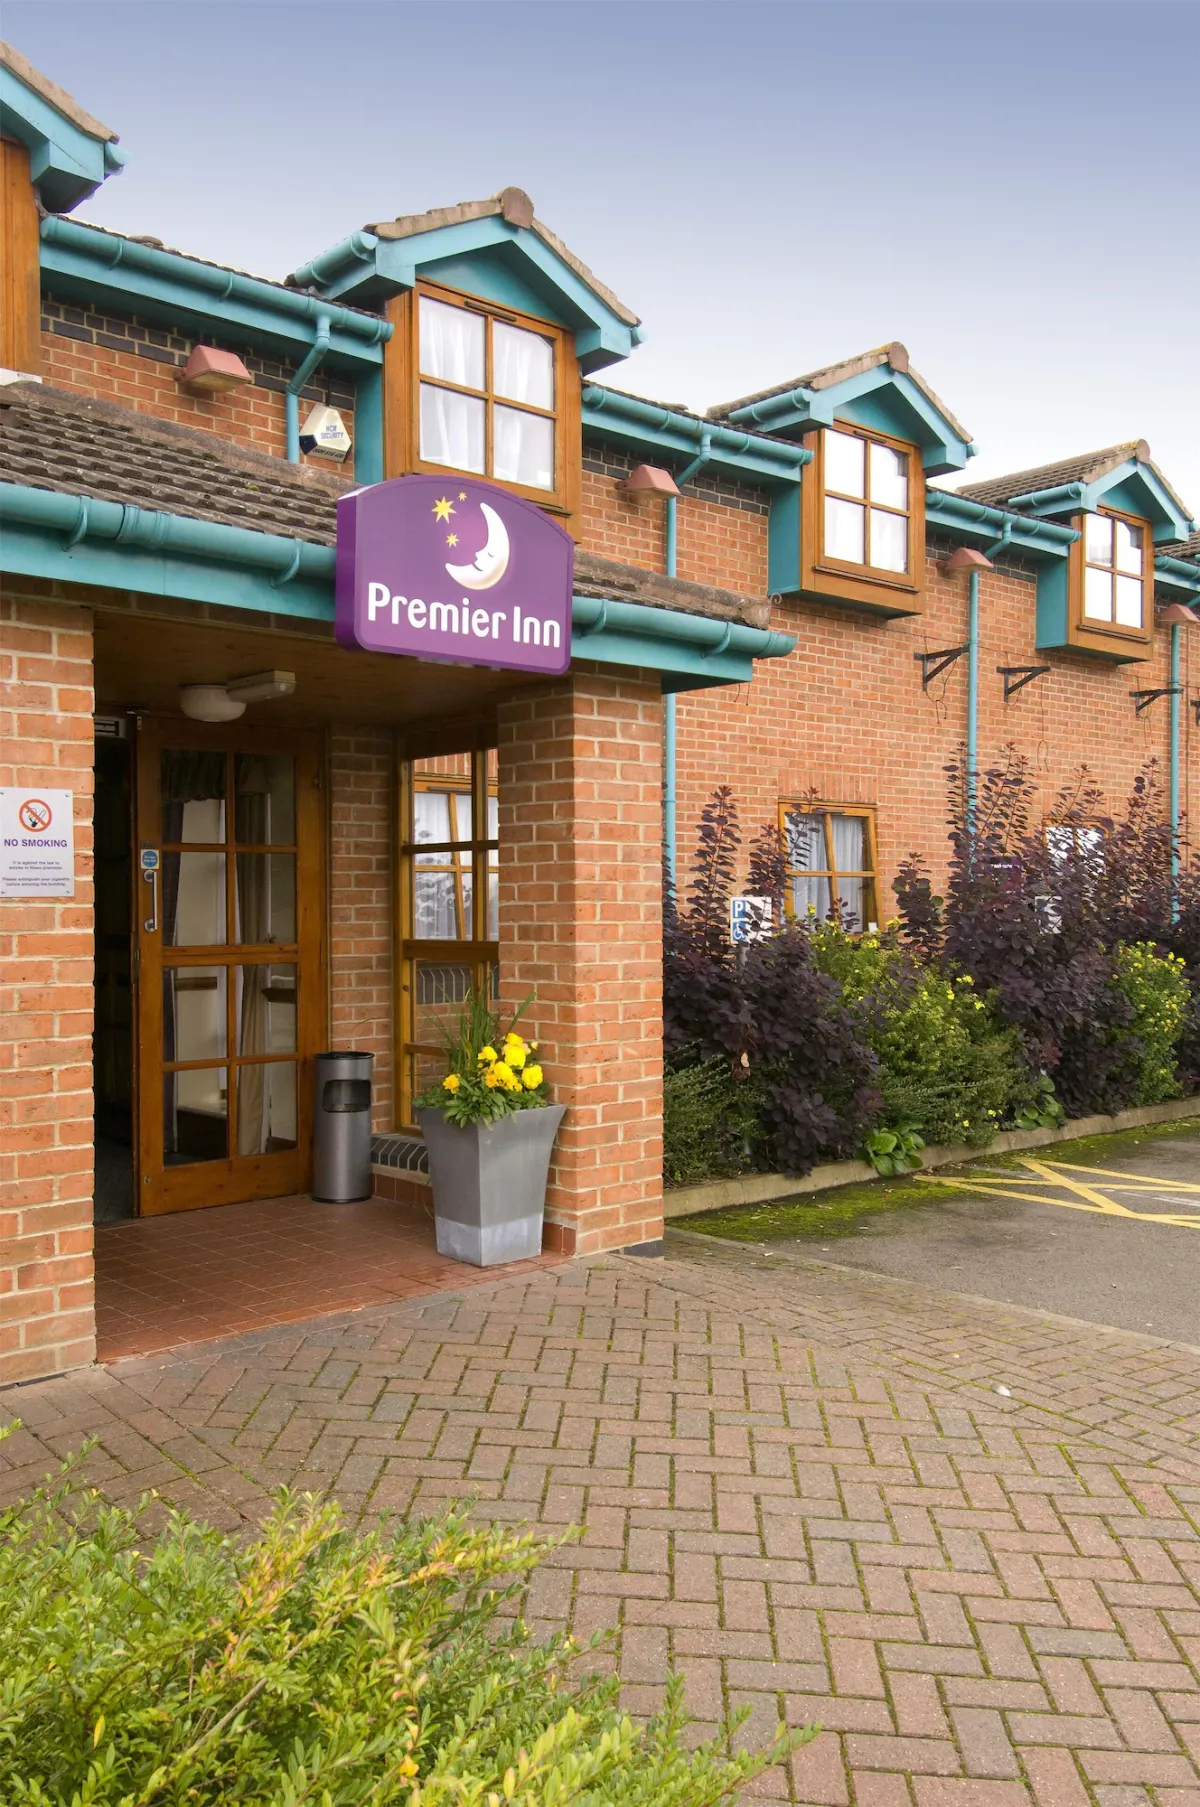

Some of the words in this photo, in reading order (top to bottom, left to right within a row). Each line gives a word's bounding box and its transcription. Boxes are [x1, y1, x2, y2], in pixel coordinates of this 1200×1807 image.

[368, 582, 506, 639] Premier
[513, 606, 560, 648] Inn
[4, 838, 18, 846] NO
[22, 839, 67, 847] SMOKING
[735, 901, 743, 917] P
